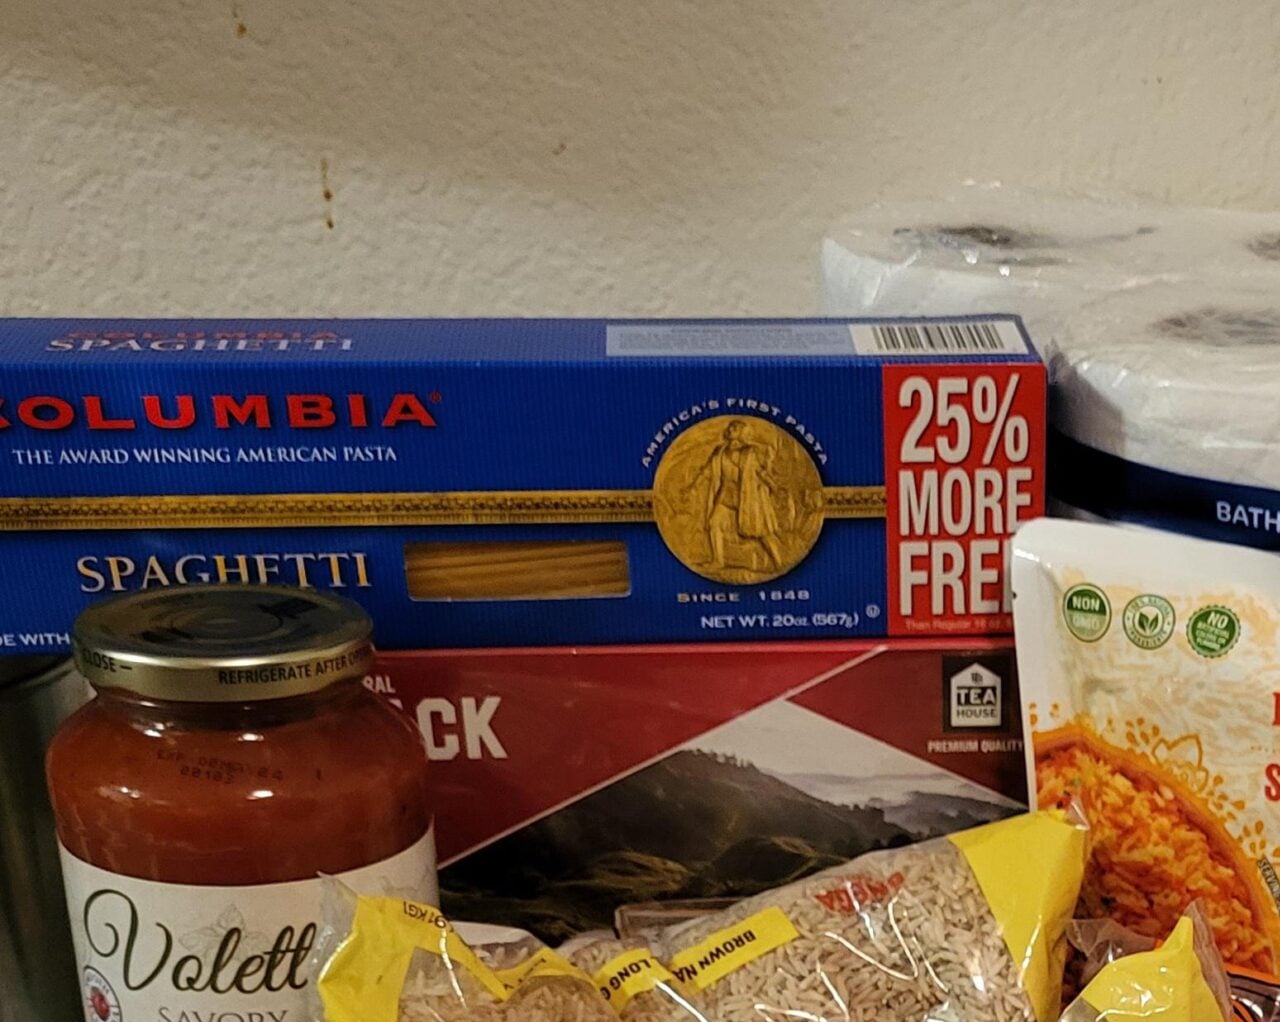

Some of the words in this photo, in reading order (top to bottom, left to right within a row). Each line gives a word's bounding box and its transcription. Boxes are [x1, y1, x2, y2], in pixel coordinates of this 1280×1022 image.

[45, 338, 353, 351] SPAGHETTI
[0, 394, 438, 430] OLUMBIA
[899, 373, 1029, 465] 25%
[642, 400, 719, 468] AMERICA'S
[727, 398, 781, 417] FIRST
[785, 415, 828, 465] PASTA
[12, 449, 54, 465] THE
[59, 448, 128, 465] AWARD
[133, 448, 230, 465] WINNING
[236, 446, 337, 464] AMERICAN
[343, 446, 397, 463] PASTA
[899, 467, 1032, 535] MORE
[77, 553, 372, 592] SPAGHETTI
[678, 593, 740, 603] SINCE
[1072, 596, 1100, 612] NON
[701, 615, 735, 628] NET
[739, 615, 769, 627] WT.
[1207, 611, 1229, 628] NO
[20, 633, 71, 645] WITH
[218, 662, 311, 685] REFRIGERATE
[316, 659, 347, 676] AFTER
[957, 688, 996, 705] TEA
[957, 709, 997, 719] HOUSE
[927, 740, 978, 754] PREMIUM
[981, 739, 1023, 754] QUALITY
[84, 889, 317, 993] Volett
[698, 930, 756, 969] BROWN
[609, 959, 651, 991] LONG
